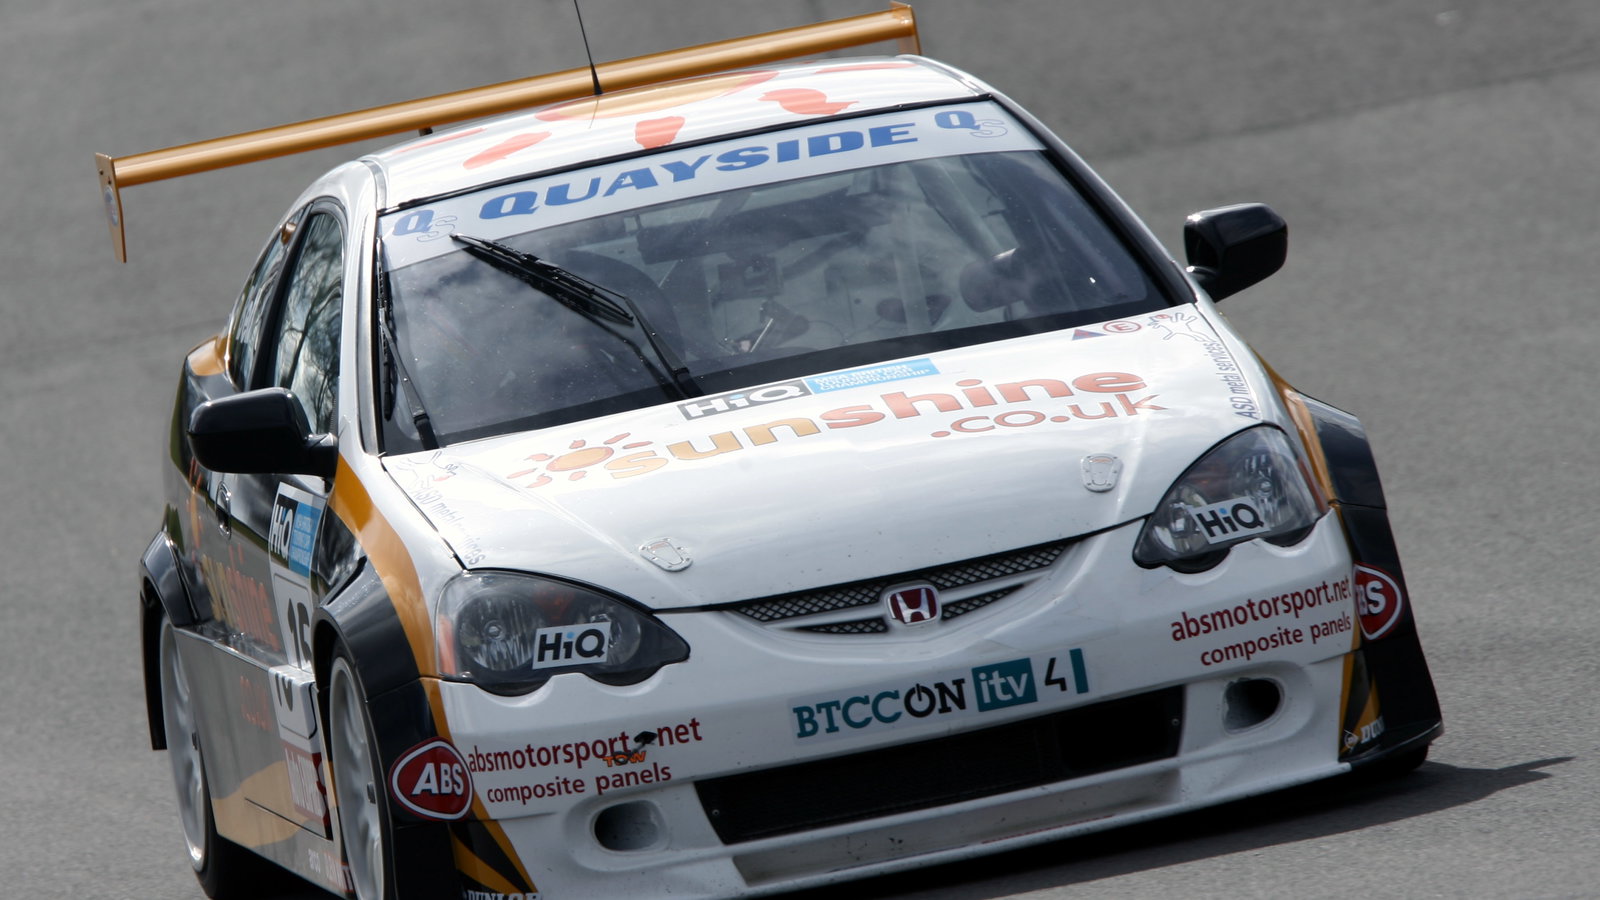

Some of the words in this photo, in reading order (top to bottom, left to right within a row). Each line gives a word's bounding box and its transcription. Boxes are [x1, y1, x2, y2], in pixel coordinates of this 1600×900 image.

[478, 122, 919, 220] QUAYSIDE
[1202, 341, 1237, 373] services
[1215, 371, 1250, 396] metal
[684, 385, 804, 418] HiQ
[1229, 393, 1262, 421] ASD
[604, 370, 1148, 479] sunshine
[1196, 503, 1265, 538] HiQ
[1171, 575, 1351, 641] absmotorsport.net
[537, 627, 606, 662] HiQ
[1201, 626, 1303, 666] composite
[1310, 611, 1351, 644] panels
[980, 672, 1029, 704] itv
[602, 750, 647, 767] TOW
[411, 762, 465, 796] ABS
[487, 776, 585, 805] composite
[595, 762, 672, 795] panels
